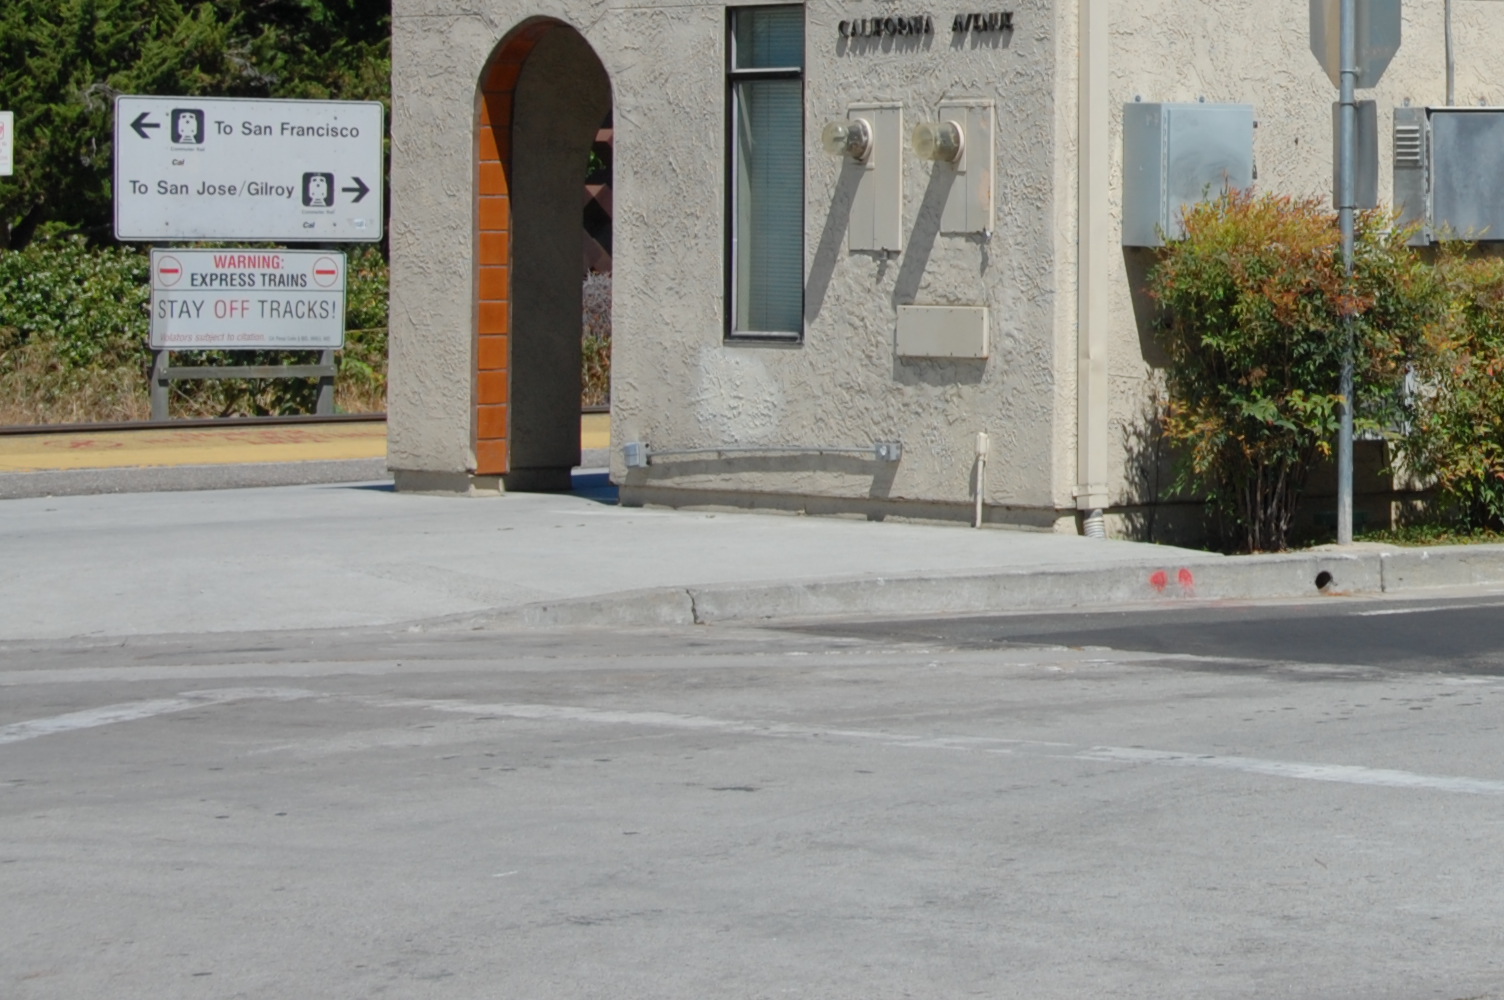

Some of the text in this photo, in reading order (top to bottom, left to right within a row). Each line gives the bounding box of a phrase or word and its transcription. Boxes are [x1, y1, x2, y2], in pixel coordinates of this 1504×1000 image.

[838, 12, 1014, 38] CALIFORNIA AVENUE
[214, 120, 360, 138] To San Francisco
[129, 180, 295, 199] To San Jose/Gilroy
[302, 221, 316, 229] Cal
[213, 254, 285, 270] WARNING:
[190, 273, 307, 288] EXPRESS TRAINS
[158, 299, 336, 319] STAY OFF TRACKS!
[160, 332, 193, 342] Violators
[194, 332, 226, 343] subject
[226, 332, 235, 342] to
